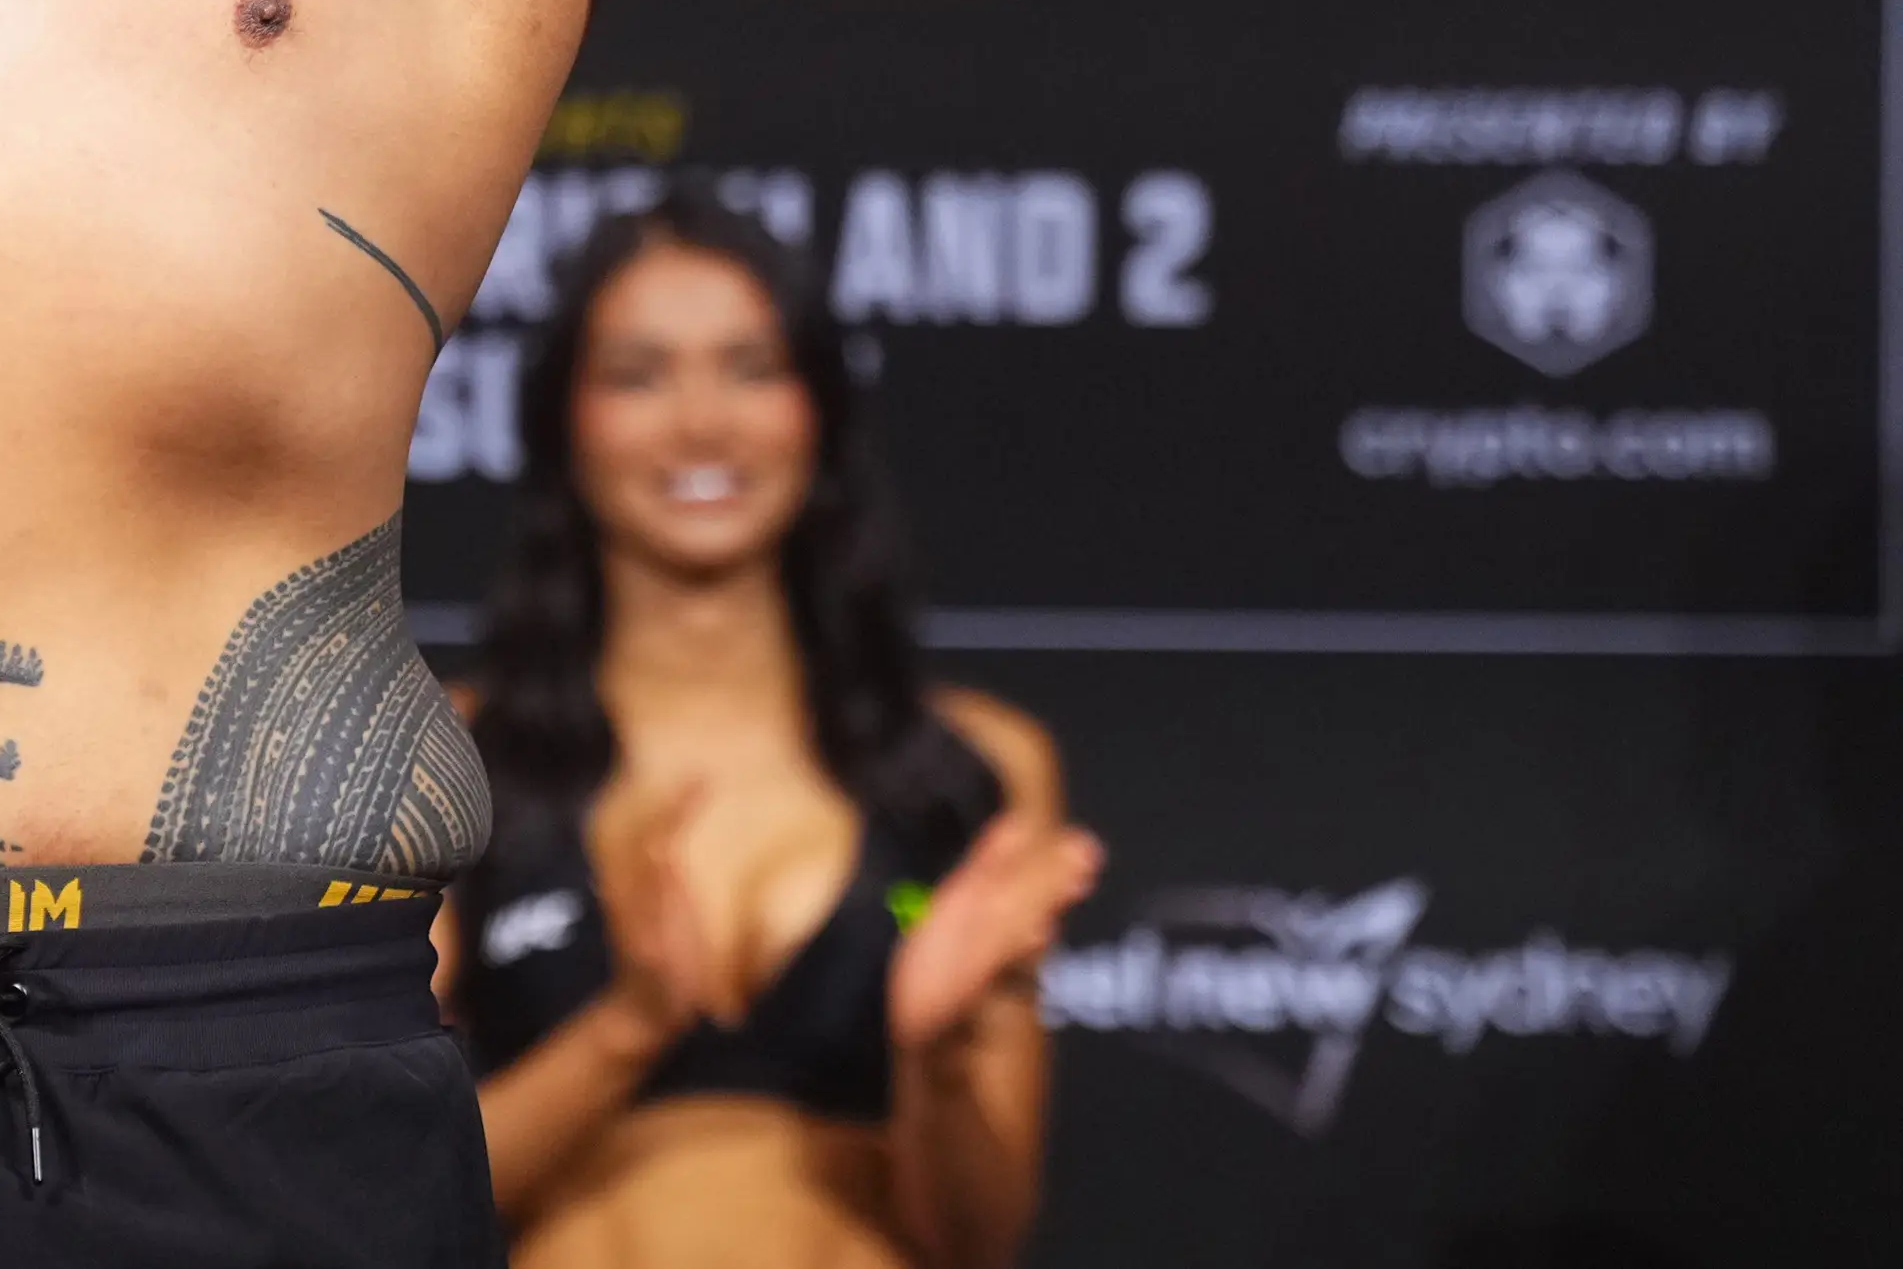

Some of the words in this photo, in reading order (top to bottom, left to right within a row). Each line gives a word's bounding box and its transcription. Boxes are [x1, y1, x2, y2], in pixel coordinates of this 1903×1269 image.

[1336, 83, 1684, 165] PRESENTED
[1690, 84, 1786, 165] BY
[1116, 168, 1214, 327] 2
[1338, 405, 1778, 489] crypto.com
[1390, 929, 1732, 1057] sydney
